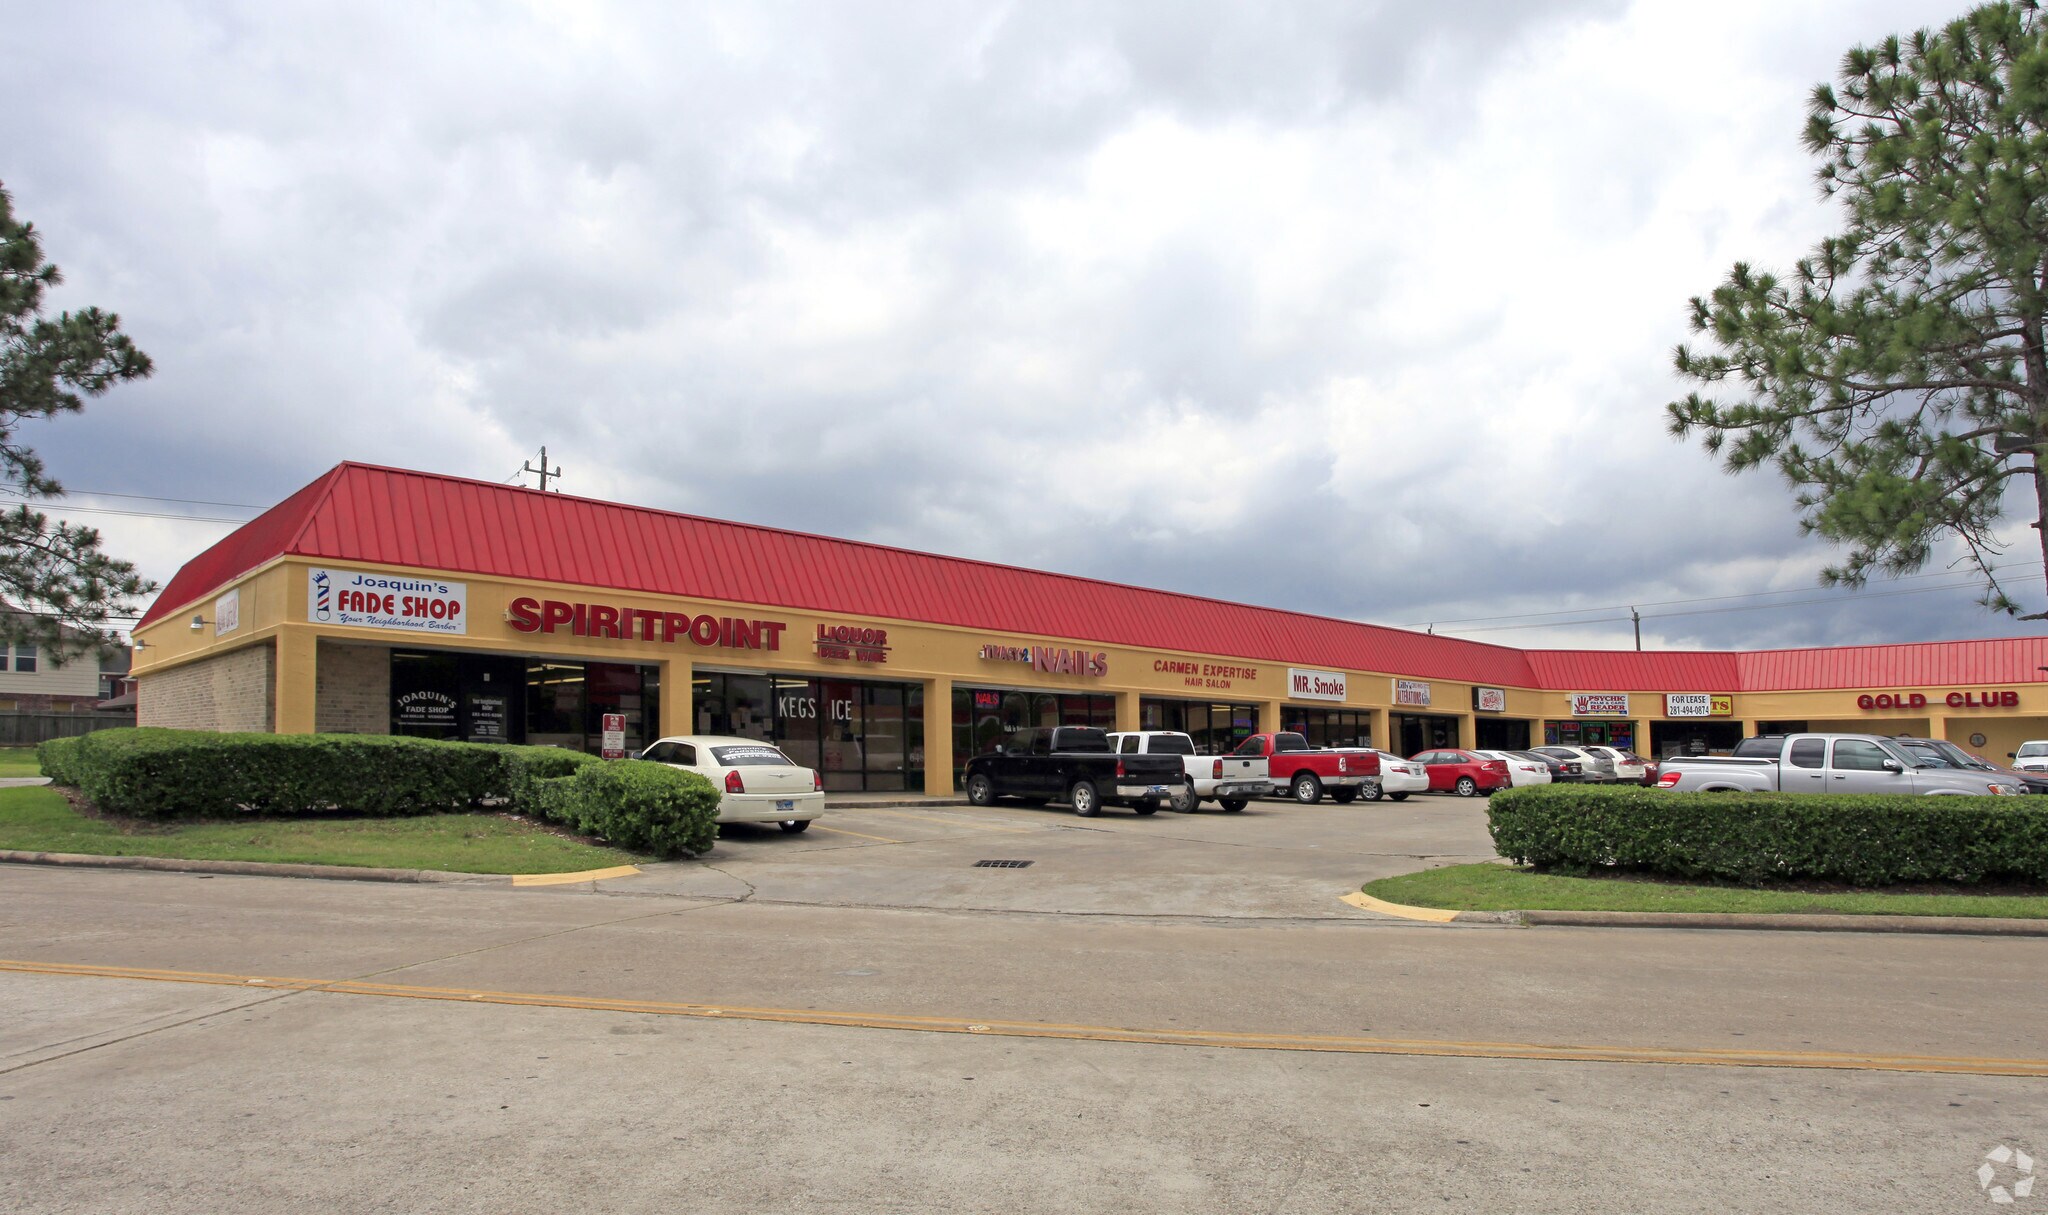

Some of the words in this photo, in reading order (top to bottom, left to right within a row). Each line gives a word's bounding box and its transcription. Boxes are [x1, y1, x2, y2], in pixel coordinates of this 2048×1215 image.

[351, 574, 449, 594] Joaquin's
[338, 589, 395, 616] FADE
[402, 595, 461, 621] SHOP
[366, 614, 425, 629] Neighborhood
[510, 596, 787, 651] SPIRITPOINT
[817, 623, 888, 646] LIQUOR
[1032, 645, 1108, 678] NAILS
[1154, 659, 1199, 676] CARMEN
[1203, 663, 1257, 681] EXPERTISE
[1185, 677, 1203, 687] HAIR
[1206, 679, 1231, 689] SALON
[1294, 674, 1312, 693] MR.
[1314, 676, 1345, 696] Smoke
[397, 691, 456, 709] JOAQUIN'S
[428, 706, 449, 714] SHOP
[779, 697, 816, 719] KEGS
[831, 699, 853, 720] ICE
[1672, 695, 1686, 704] FOR
[1686, 695, 1706, 704] LEASE
[1857, 693, 1927, 710] GOLD
[1946, 691, 2020, 708] CLUB
